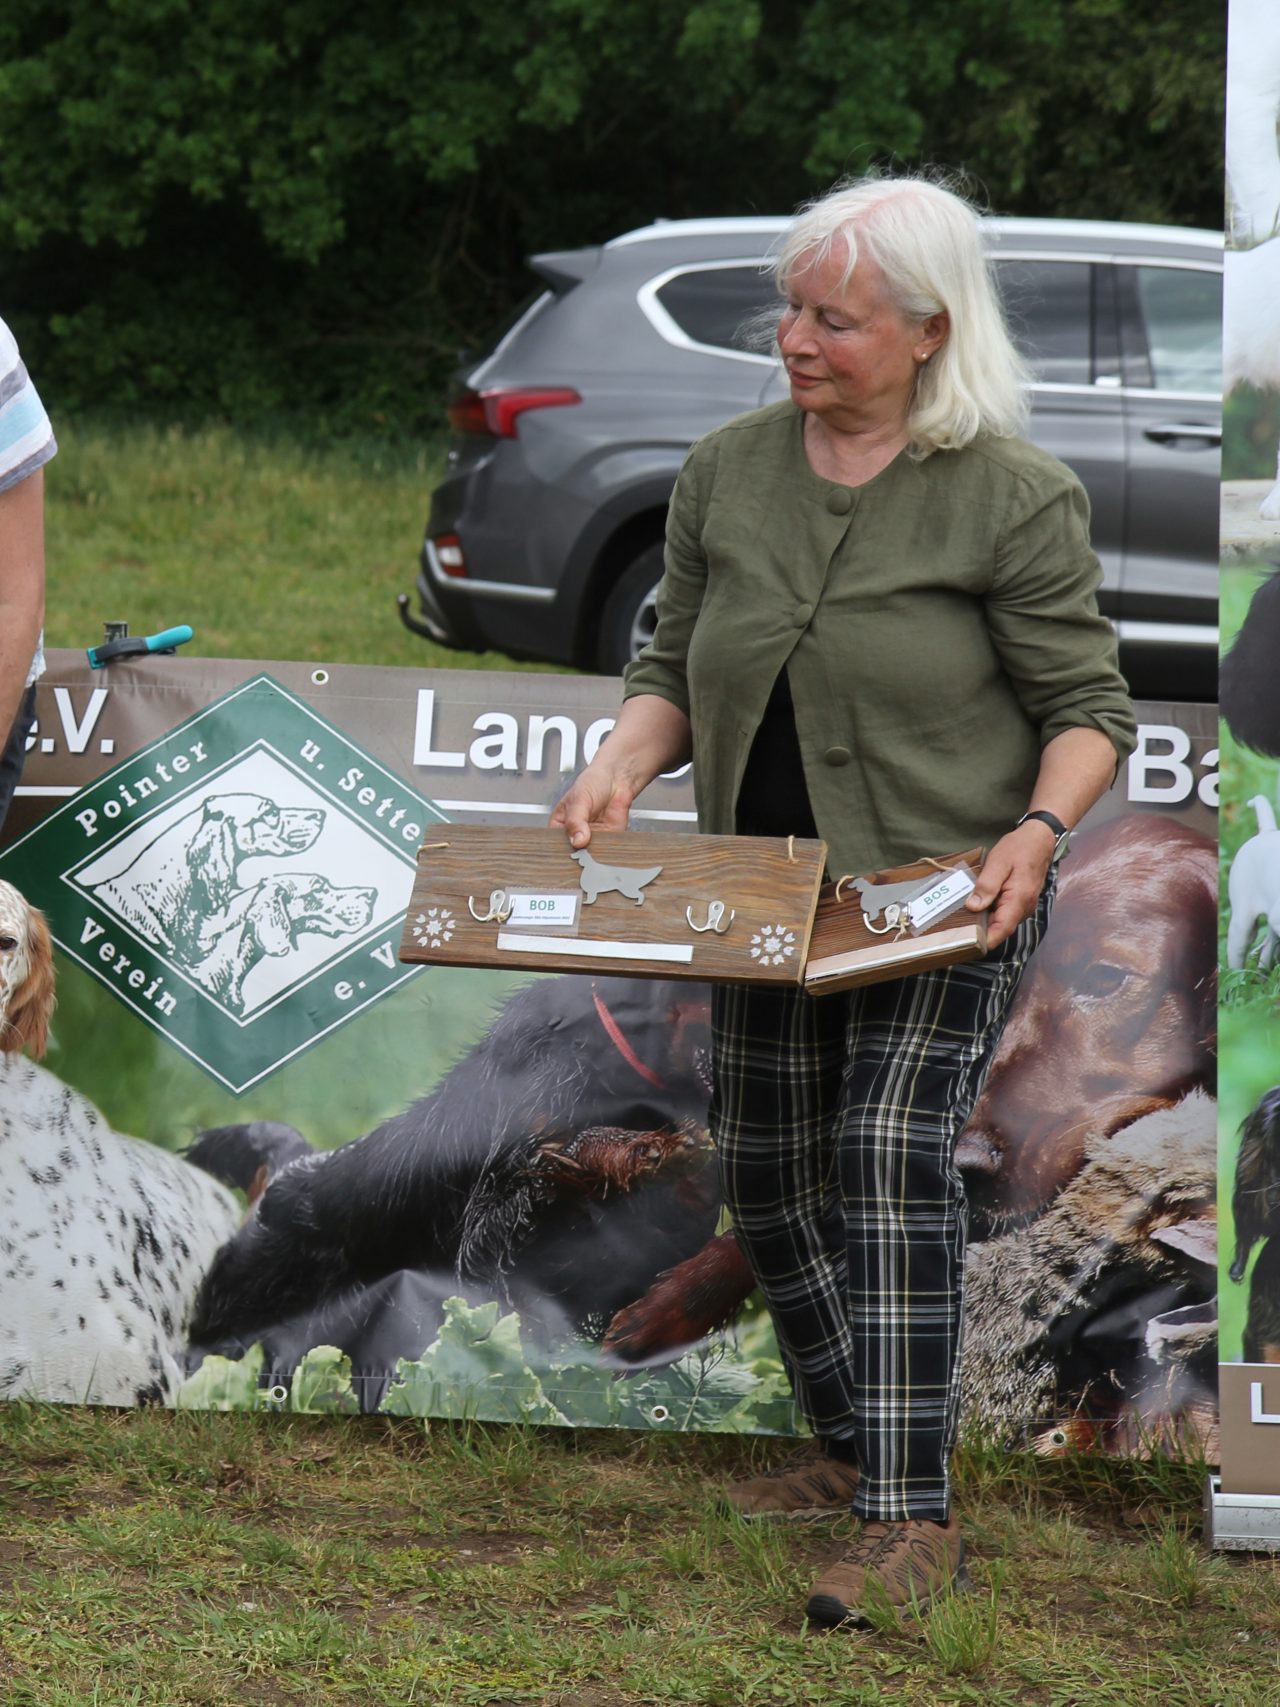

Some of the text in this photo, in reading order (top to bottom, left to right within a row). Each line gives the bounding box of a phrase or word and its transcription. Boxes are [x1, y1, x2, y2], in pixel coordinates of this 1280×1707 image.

[74, 741, 208, 838] Pointer
[300, 739, 421, 841] u. Sette
[1128, 724, 1219, 807] Ba
[529, 899, 556, 911] BOB
[923, 885, 950, 905] BOS
[79, 916, 177, 1016] Verein
[334, 940, 397, 1001] e. V
